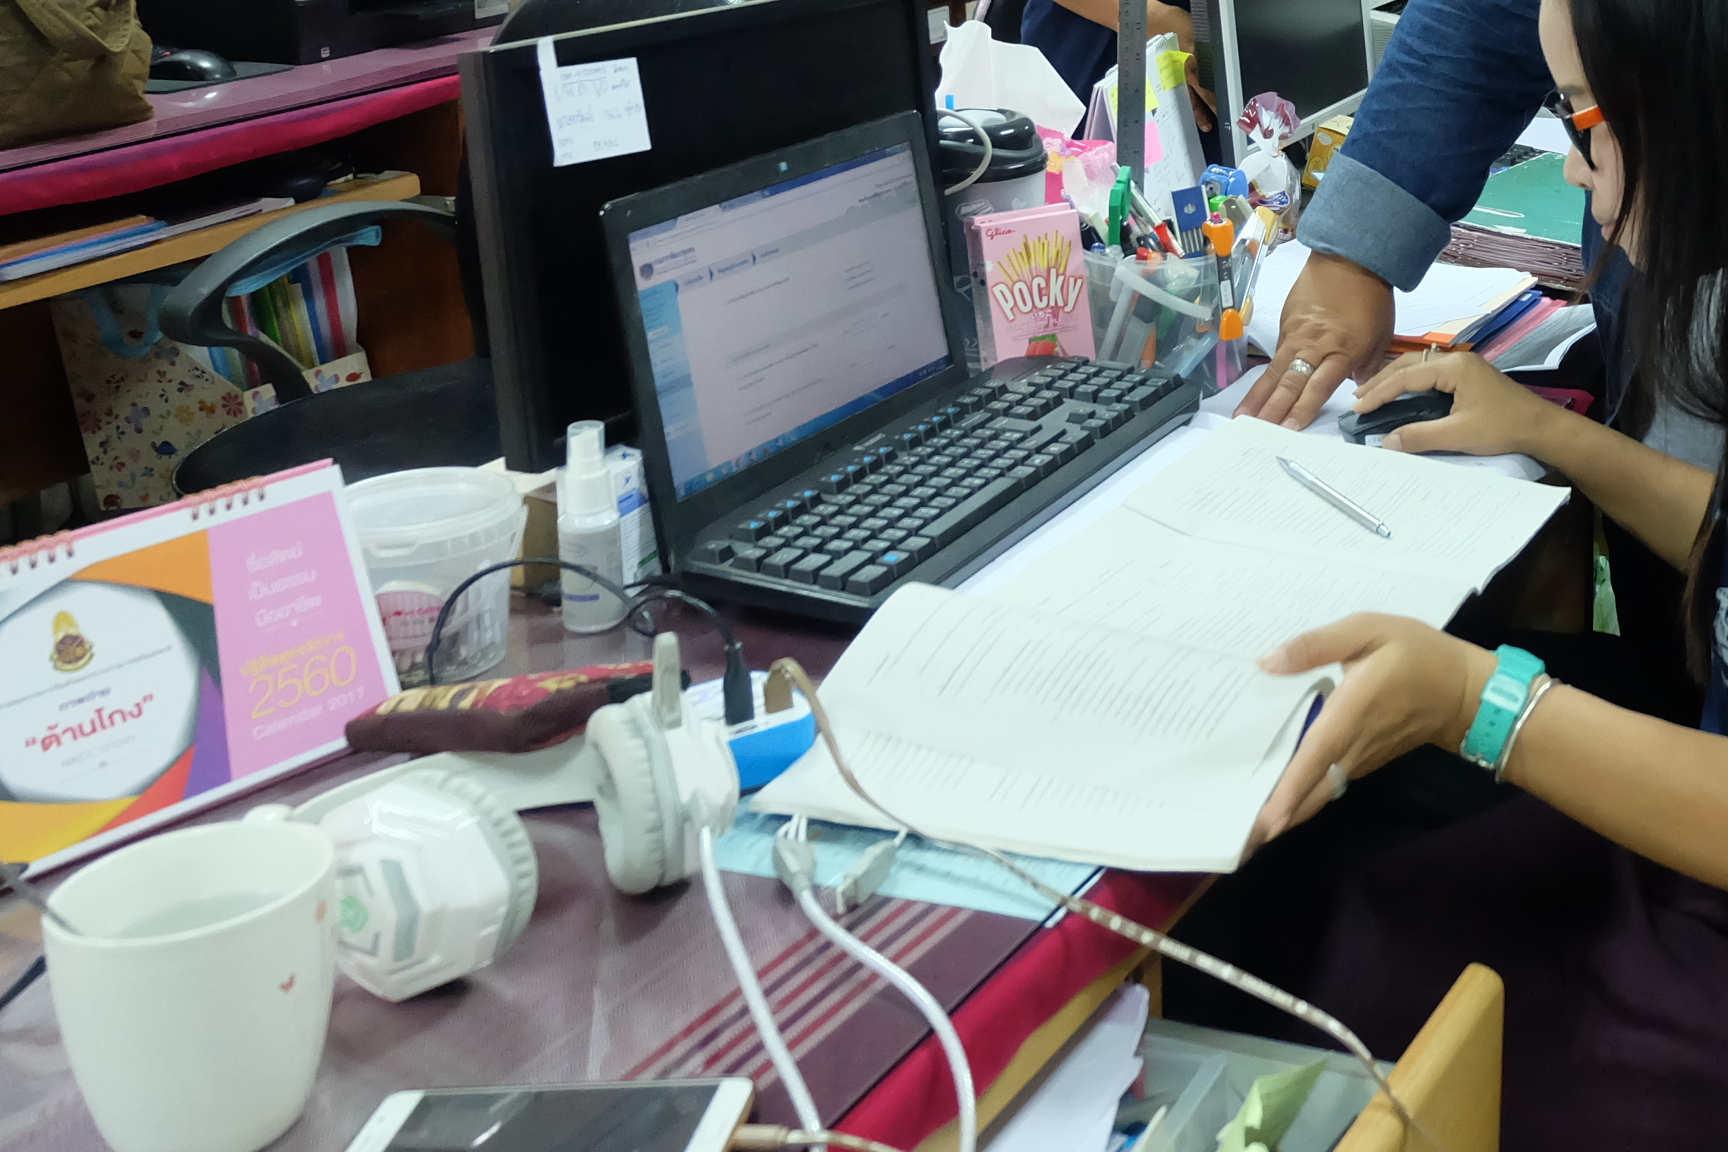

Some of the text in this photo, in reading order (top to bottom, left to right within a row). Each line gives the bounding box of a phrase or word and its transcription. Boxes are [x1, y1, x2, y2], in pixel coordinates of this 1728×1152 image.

[985, 226, 1016, 241] Glico
[992, 268, 1084, 323] Pocky
[249, 645, 358, 719] 2560
[252, 704, 324, 740] Calendar
